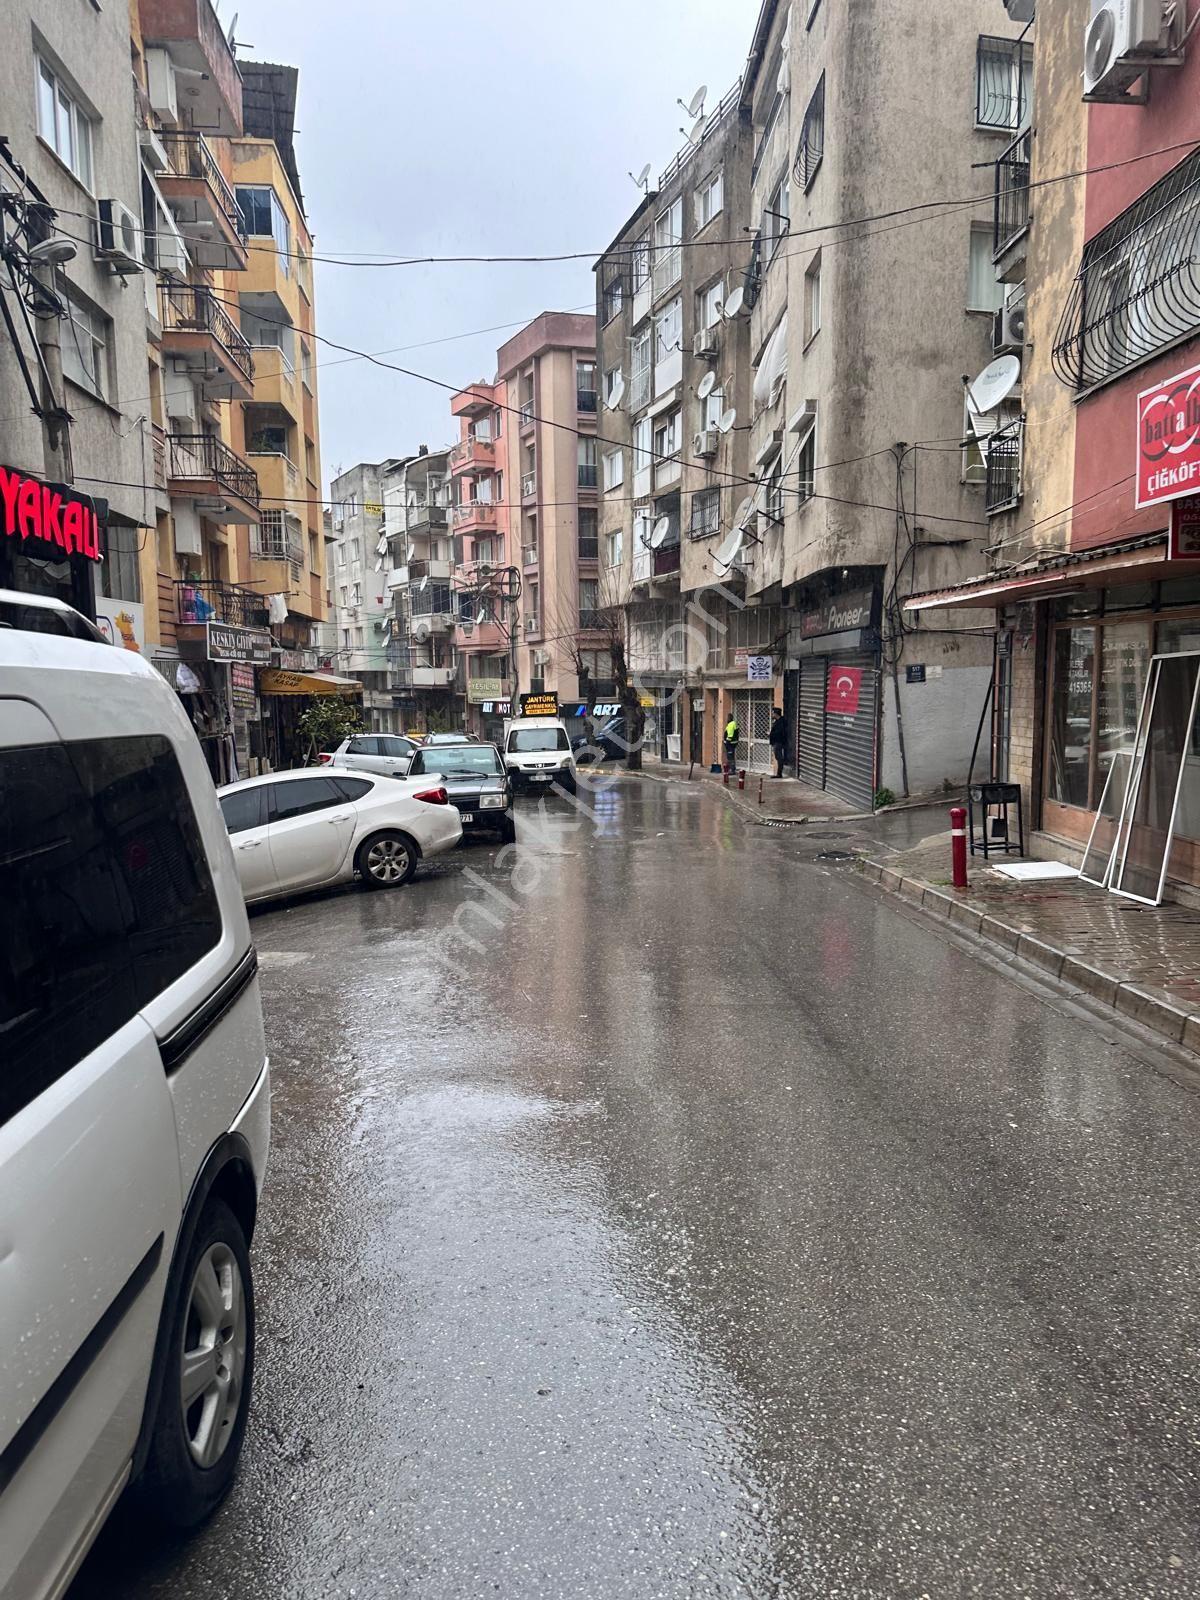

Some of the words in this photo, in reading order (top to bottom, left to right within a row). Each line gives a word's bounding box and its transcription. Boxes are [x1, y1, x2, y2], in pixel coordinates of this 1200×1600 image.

[0, 466, 99, 560] YAKALI
[828, 605, 863, 630] Pioneer
[593, 704, 621, 716] ART
